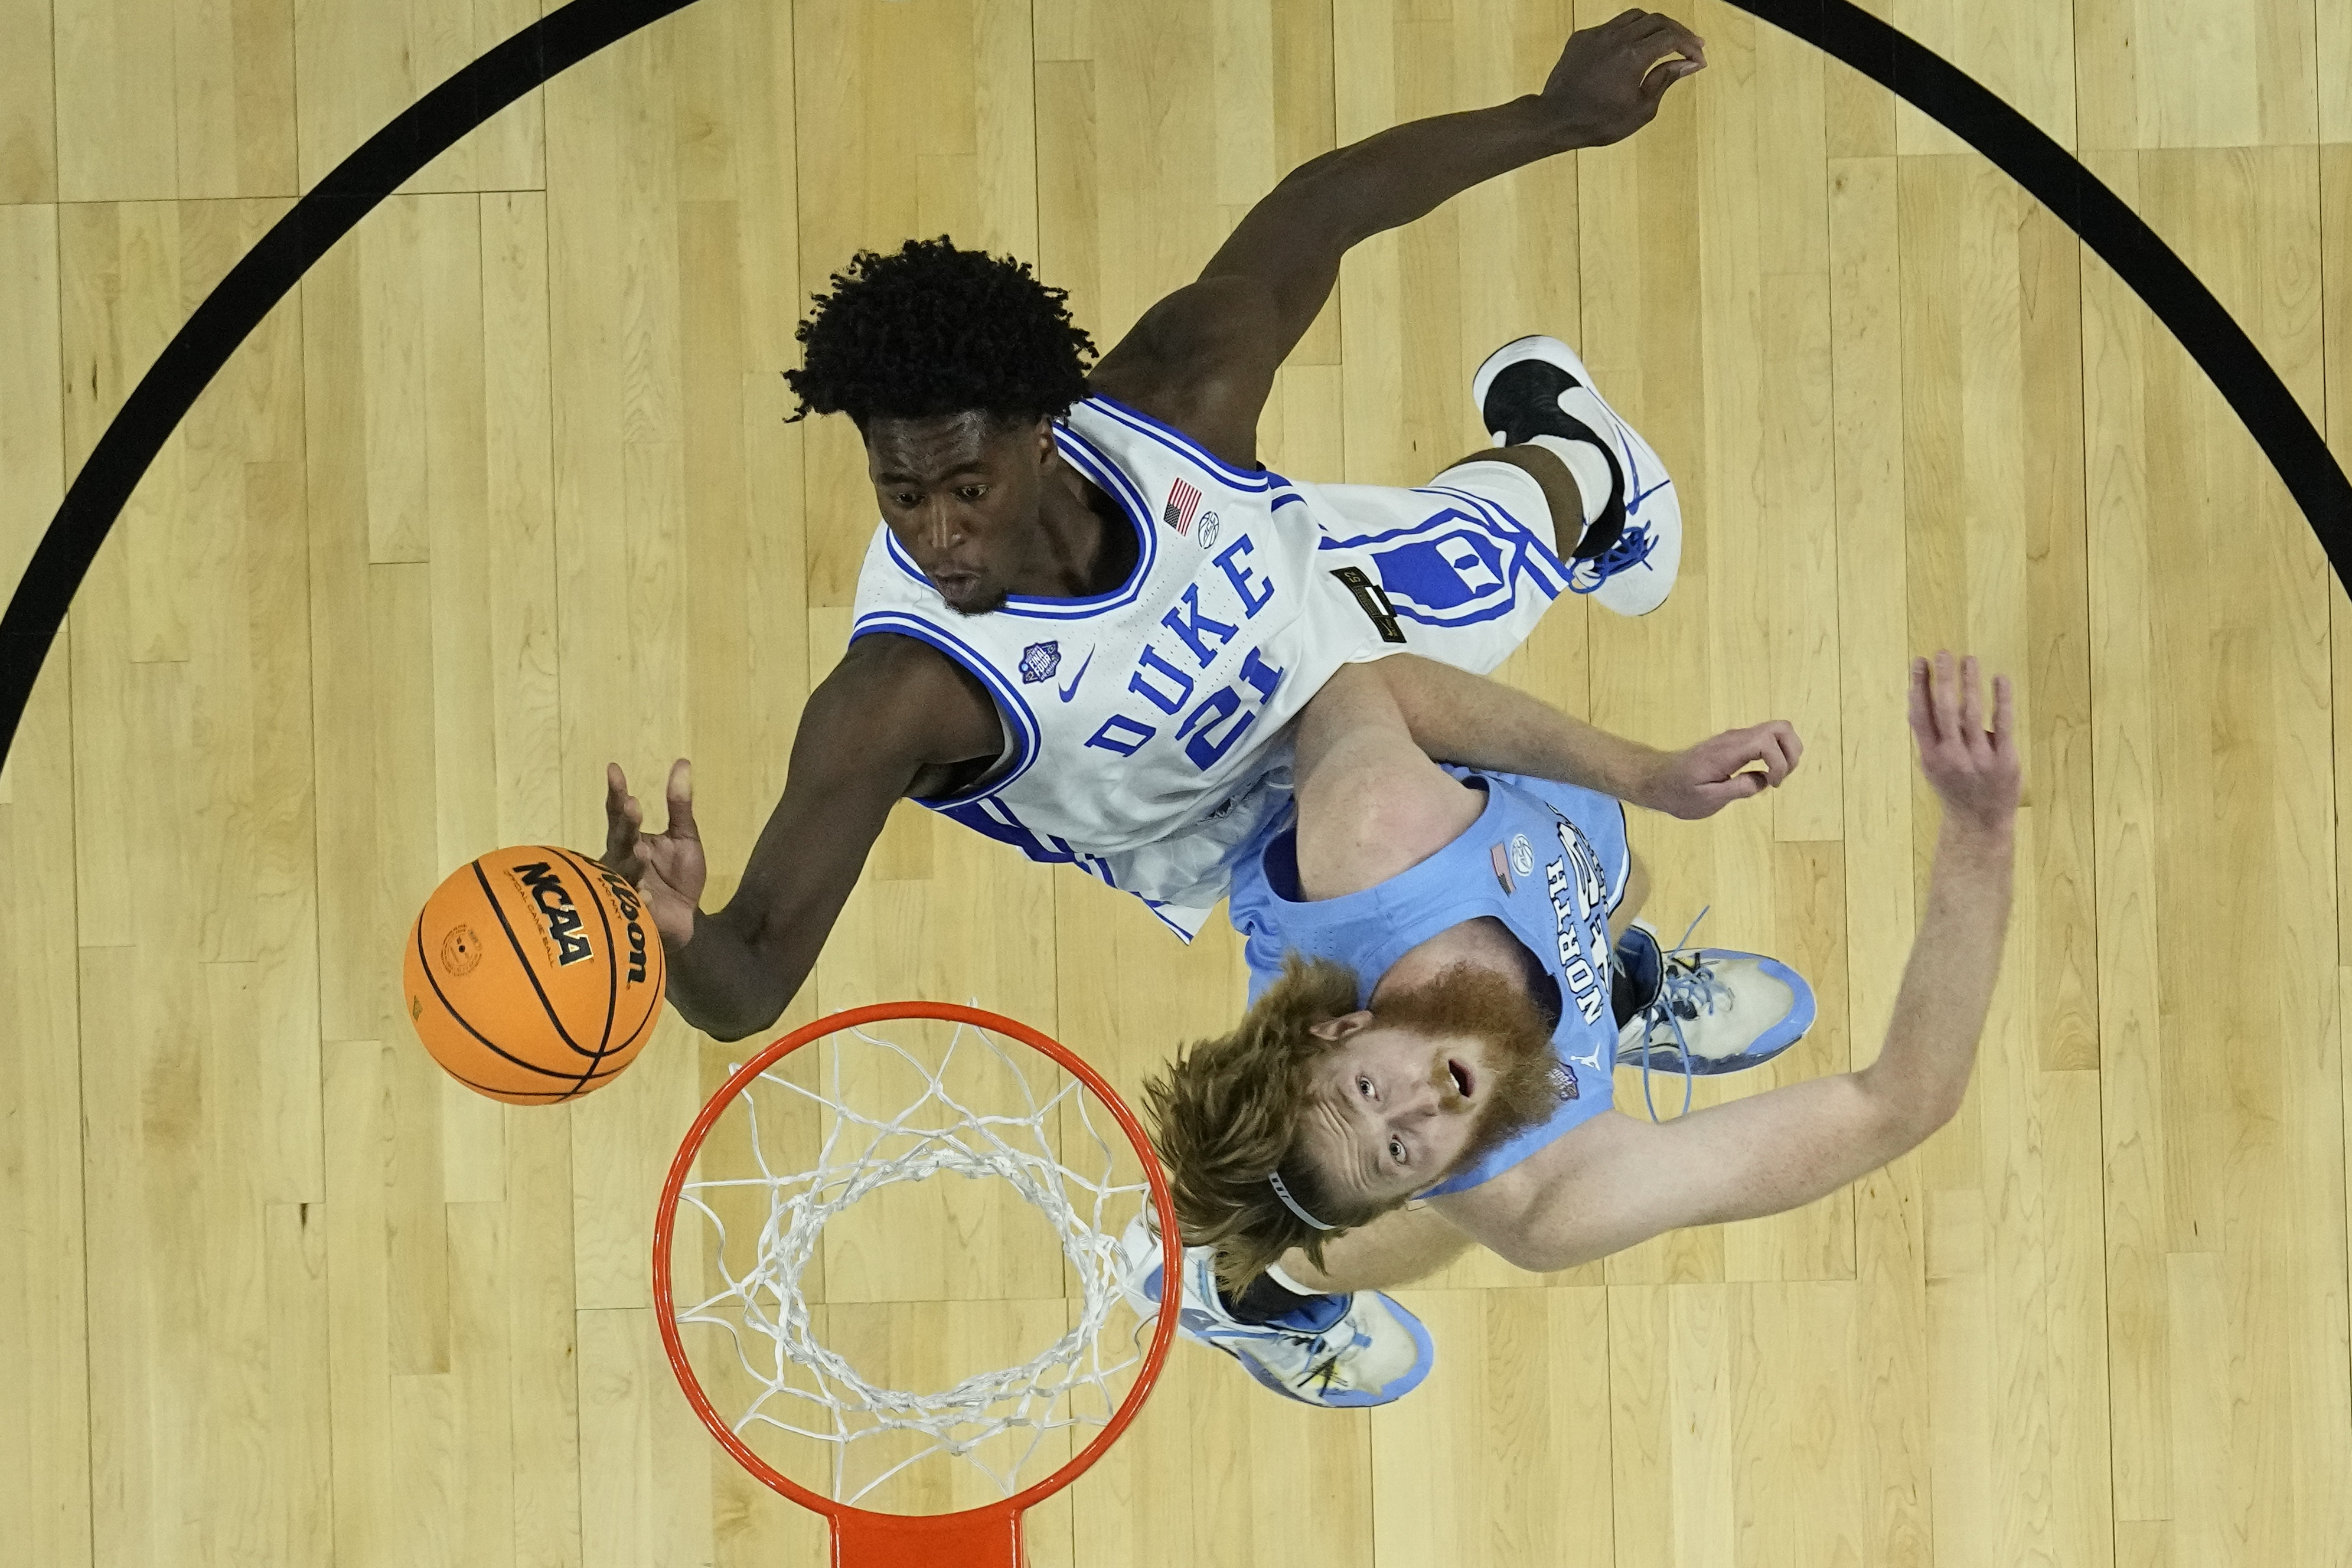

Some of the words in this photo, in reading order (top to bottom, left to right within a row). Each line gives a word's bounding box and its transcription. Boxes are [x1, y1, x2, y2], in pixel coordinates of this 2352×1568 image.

[1344, 571, 1361, 583] 52
[1029, 648, 1046, 669] FINAL
[1034, 654, 1051, 677] FOUR
[1084, 534, 1274, 757] DUKE
[1175, 646, 1284, 772] 21
[513, 862, 594, 967] NCAA
[1545, 854, 1604, 1026] NORTH
[542, 936, 554, 969] BALL
